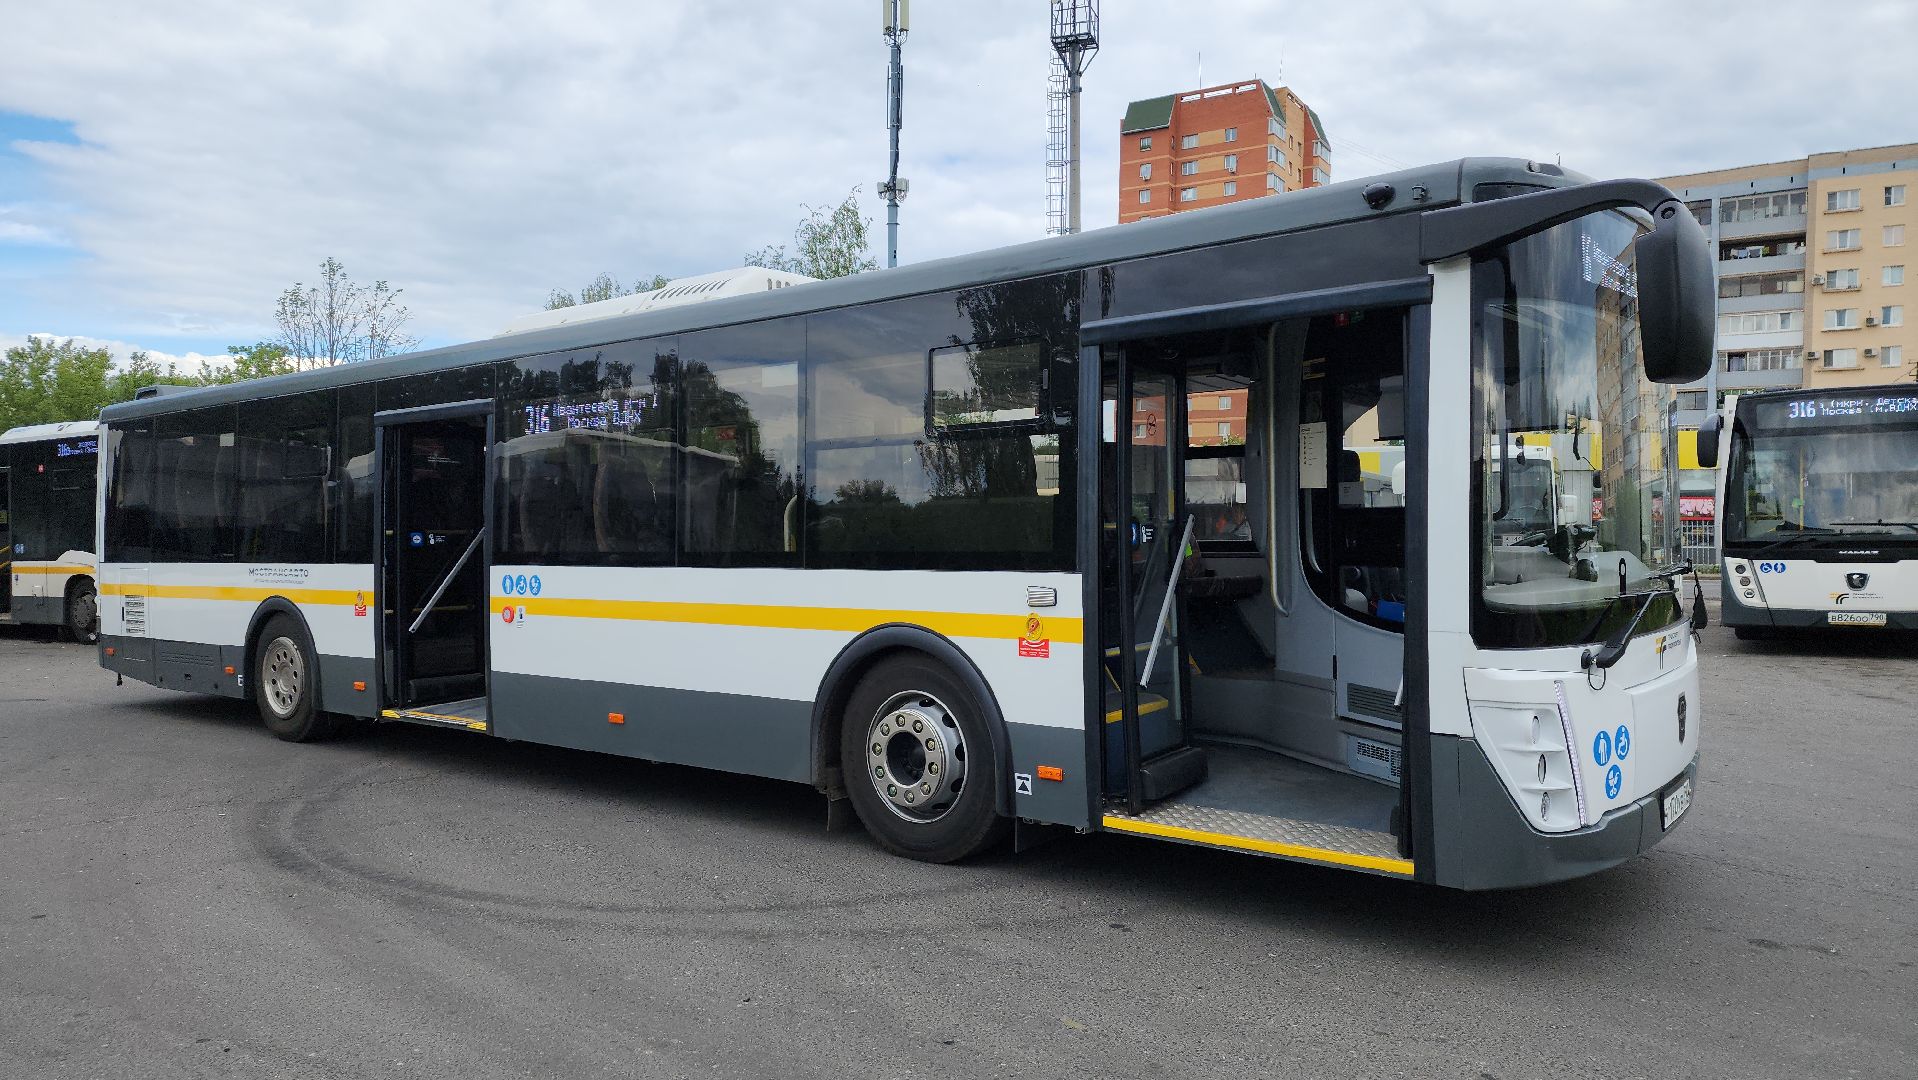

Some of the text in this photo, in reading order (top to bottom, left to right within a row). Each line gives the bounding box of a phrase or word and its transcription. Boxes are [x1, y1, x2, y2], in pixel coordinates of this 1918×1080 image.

[1789, 401, 1816, 418] 316
[1822, 407, 1863, 416] Москва
[525, 404, 550, 434] 316
[567, 408, 641, 429] Москва ВДНХ
[249, 568, 308, 577] МОСТРАНСАВТО
